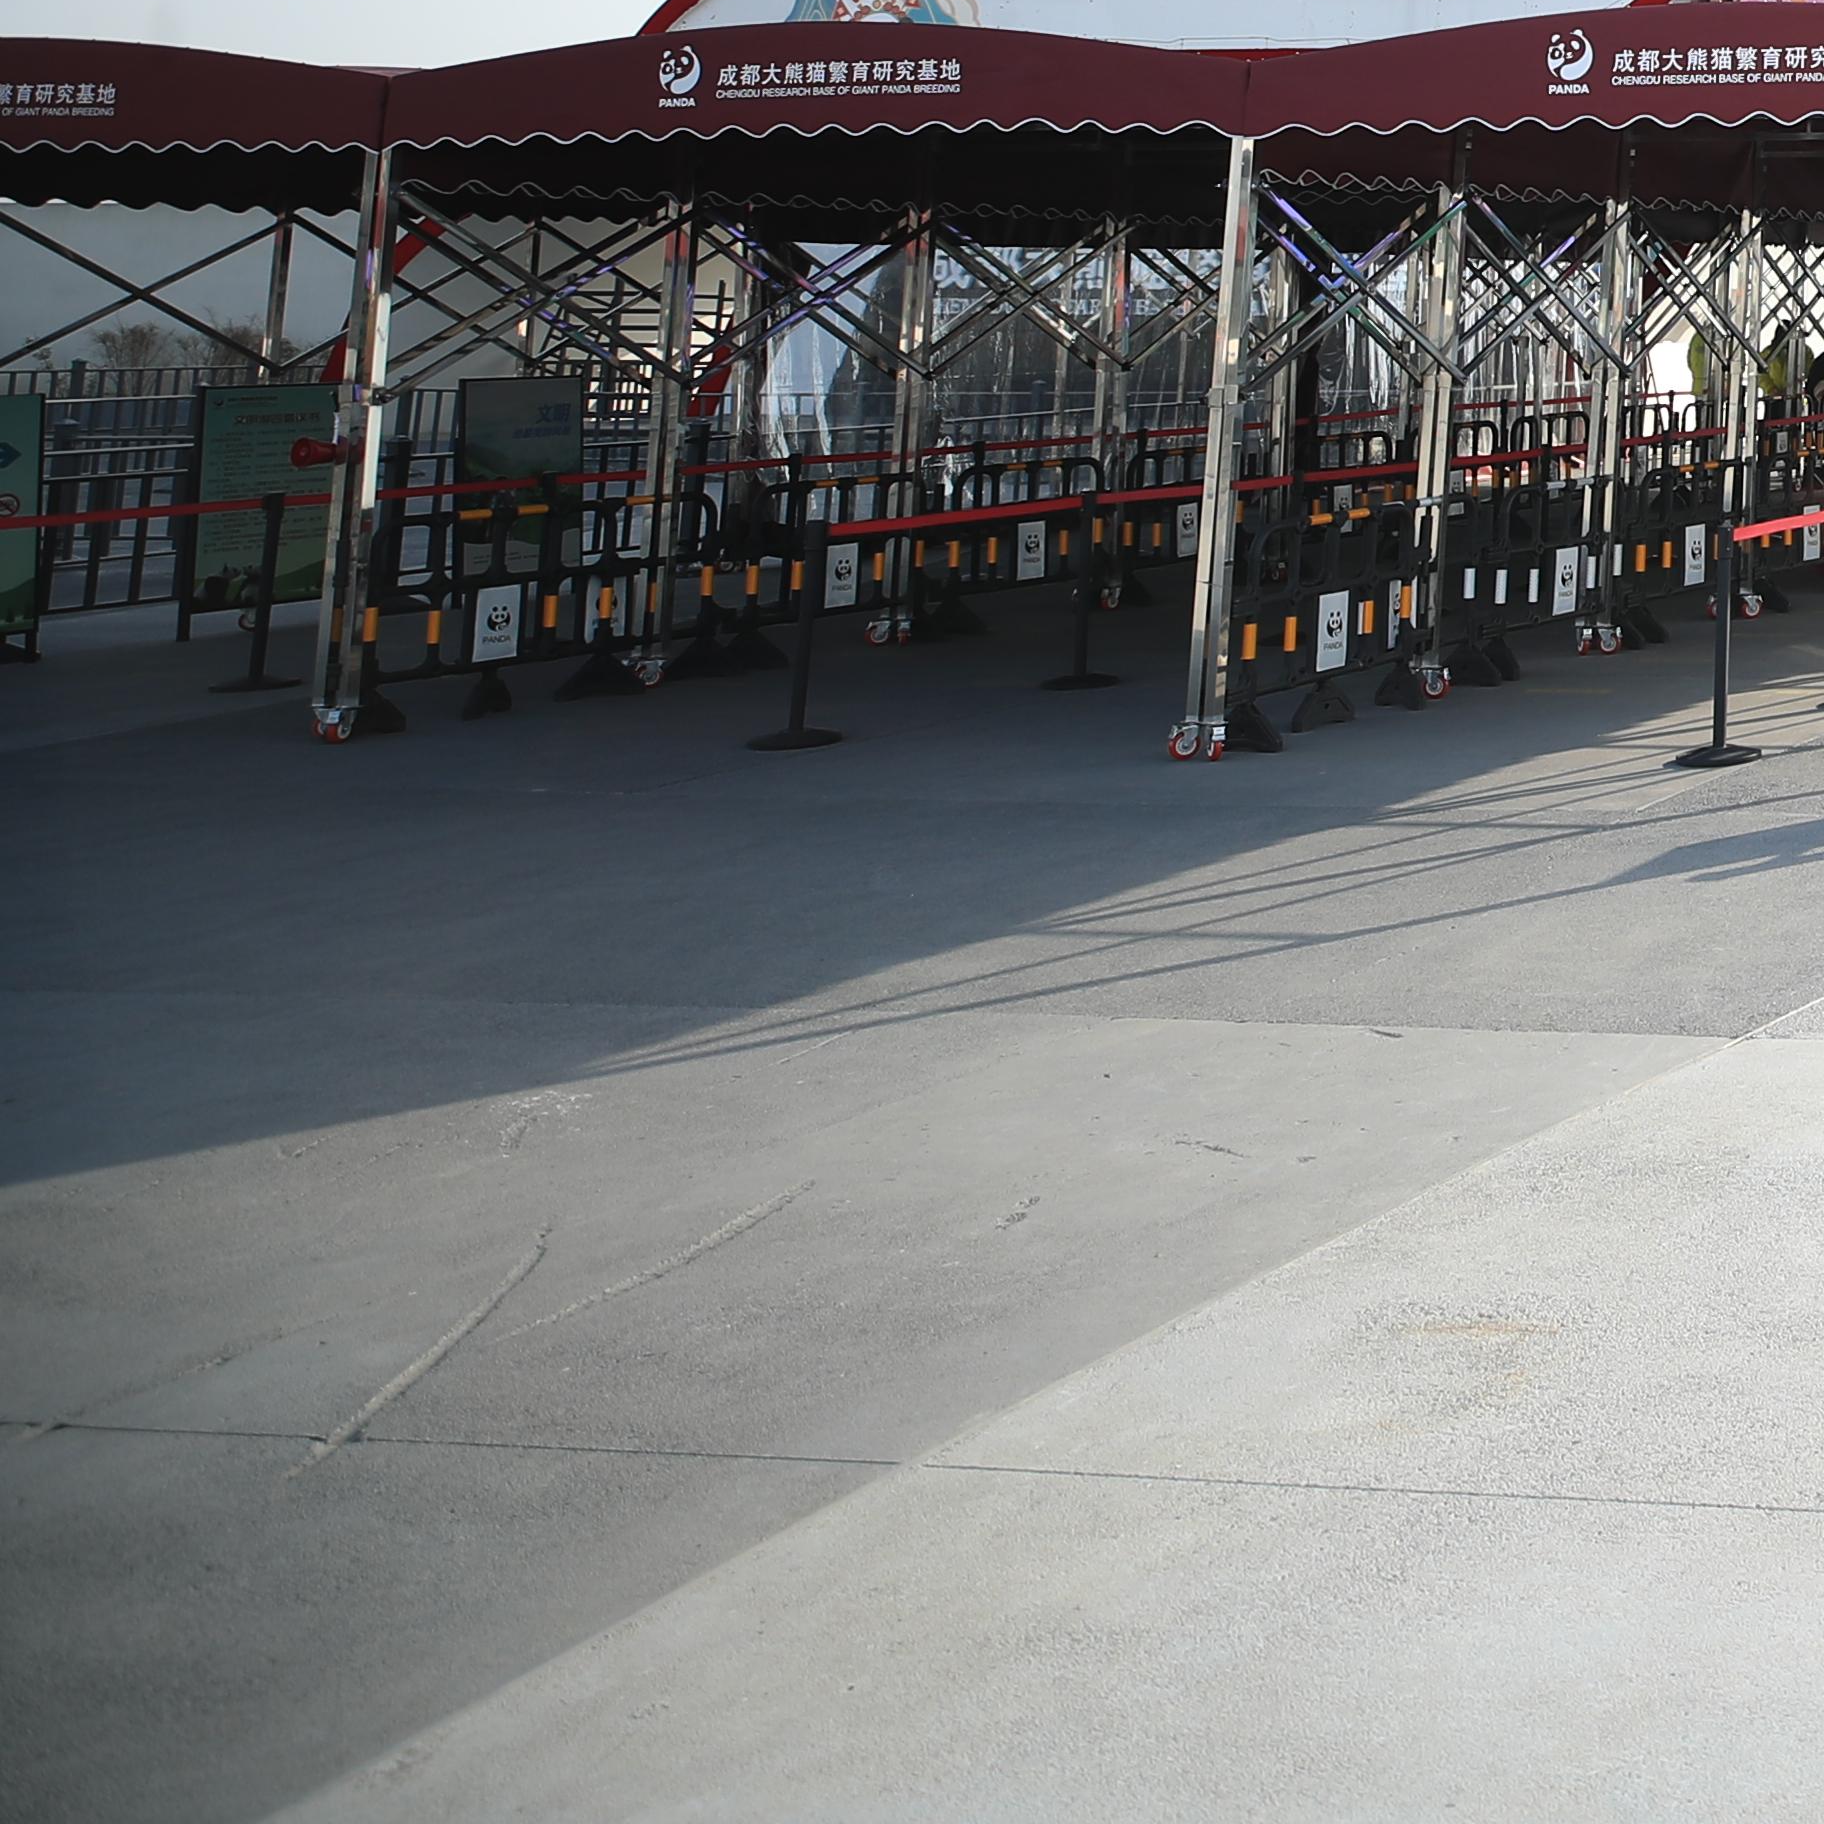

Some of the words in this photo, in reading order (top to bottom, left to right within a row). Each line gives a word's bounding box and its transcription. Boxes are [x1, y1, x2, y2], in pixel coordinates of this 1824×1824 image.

[717, 58, 961, 86] 成都大熊猫繁育研究基地
[1611, 76, 1660, 85] CHENGDU
[1662, 74, 1716, 85] RESEARCH
[1718, 73, 1744, 84] BASE
[1746, 73, 1761, 83] OF
[1763, 72, 1793, 83] GIANT
[0, 83, 116, 104] 繁育研究基地
[716, 89, 760, 99] CHENGDU
[762, 87, 811, 97] RESEARCH
[813, 86, 836, 96] BASE
[837, 85, 851, 95] OF
[852, 85, 880, 95] GIANT
[881, 84, 912, 94] PANDA
[913, 83, 961, 94] BREEDING
[1548, 84, 1590, 95] PANDA
[658, 98, 696, 108] PANDA
[2, 107, 14, 116] OF
[15, 107, 40, 116] GIANT
[42, 107, 70, 116] PANDA
[72, 107, 115, 116] BREEDING
[482, 635, 511, 644] PANDA
